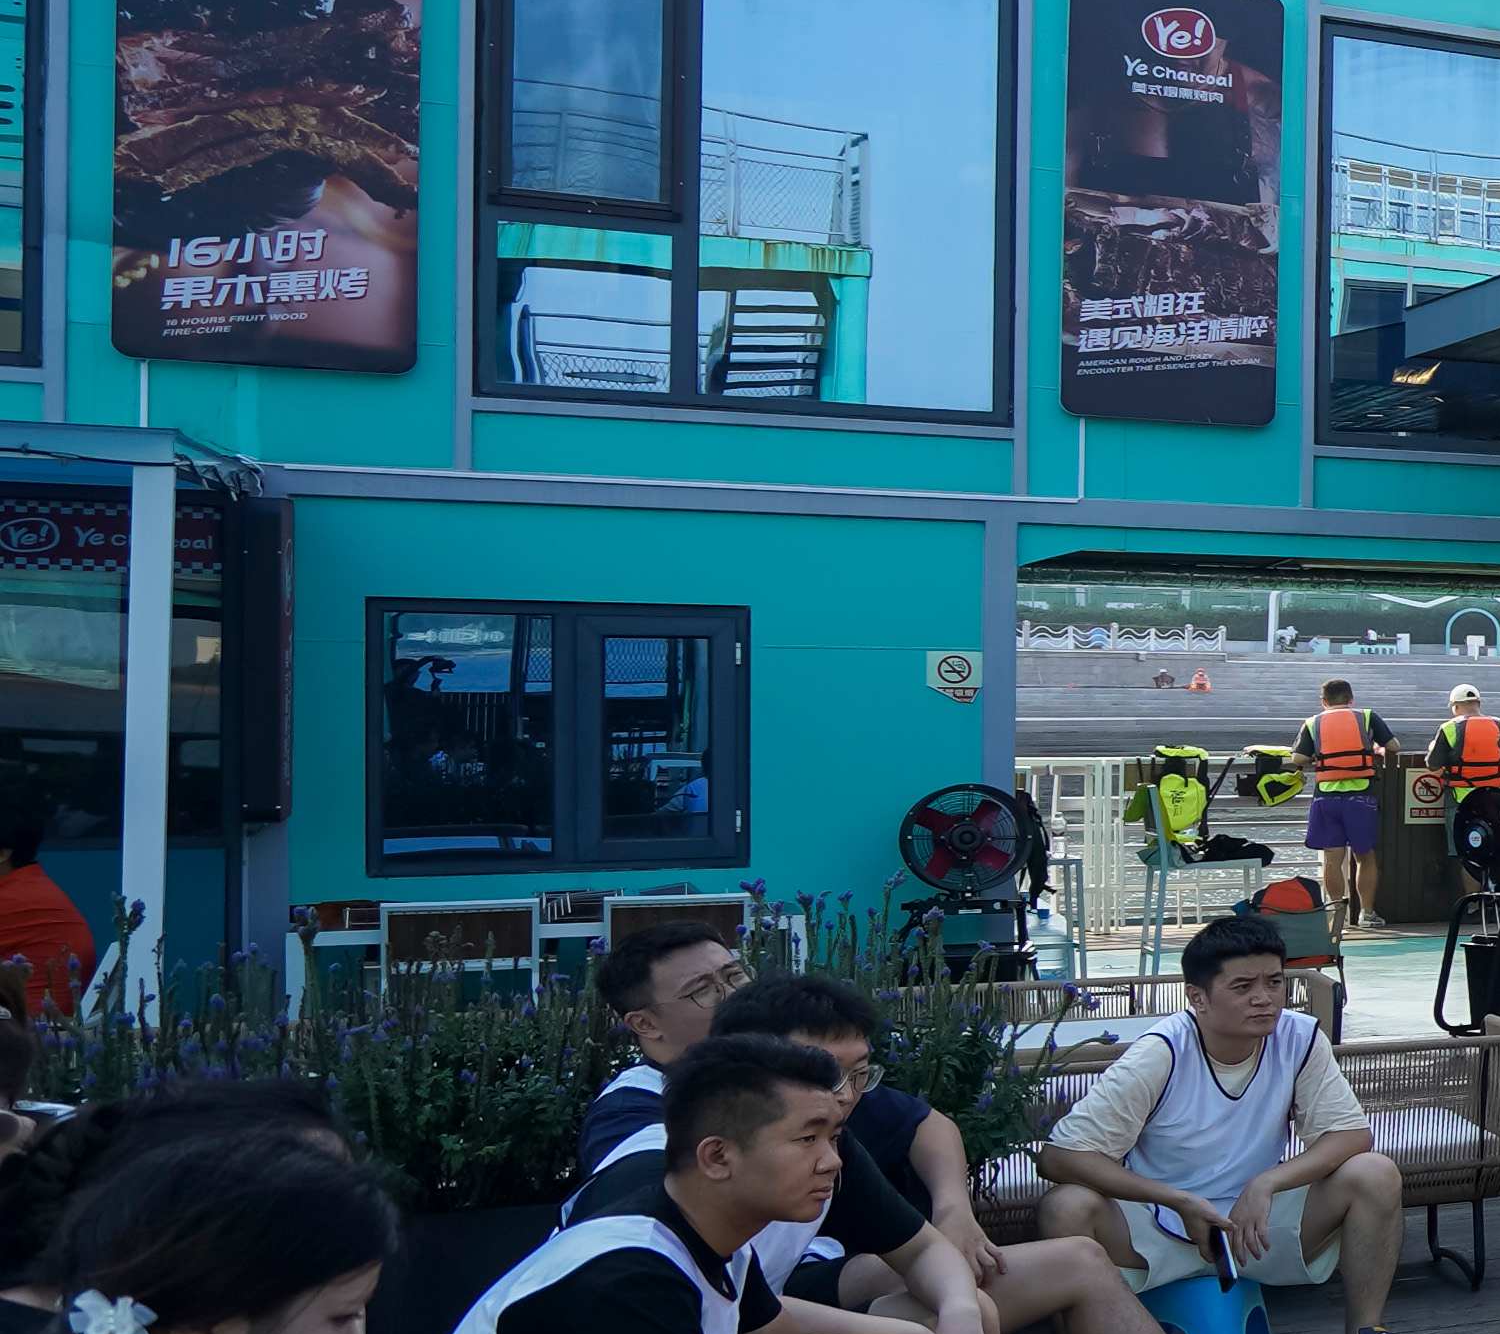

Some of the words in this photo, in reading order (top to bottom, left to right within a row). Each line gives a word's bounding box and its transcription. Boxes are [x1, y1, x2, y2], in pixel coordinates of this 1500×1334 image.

[1154, 16, 1206, 52] Ye!
[1124, 54, 1149, 77] Ye
[167, 229, 328, 268] 16小时
[160, 267, 370, 311] 果木熏烤
[1079, 292, 1206, 322] 美式粗狂
[180, 317, 226, 326] HOURS
[229, 314, 266, 322] FRUIT
[269, 312, 308, 321] WOOD
[162, 326, 232, 336] FIRE-CURE
[1078, 316, 1270, 353] 遇见海洋精粹
[1077, 366, 1134, 376] ENCOUNTER
[1155, 362, 1196, 371] ESSENCE
[1230, 357, 1261, 365] OCEAN
[1079, 358, 1127, 367] AMERICAN
[1129, 356, 1161, 364] ROUGH
[1184, 353, 1214, 361] CRAZY
[8, 524, 50, 546] Ye!
[74, 526, 104, 547] Ye
